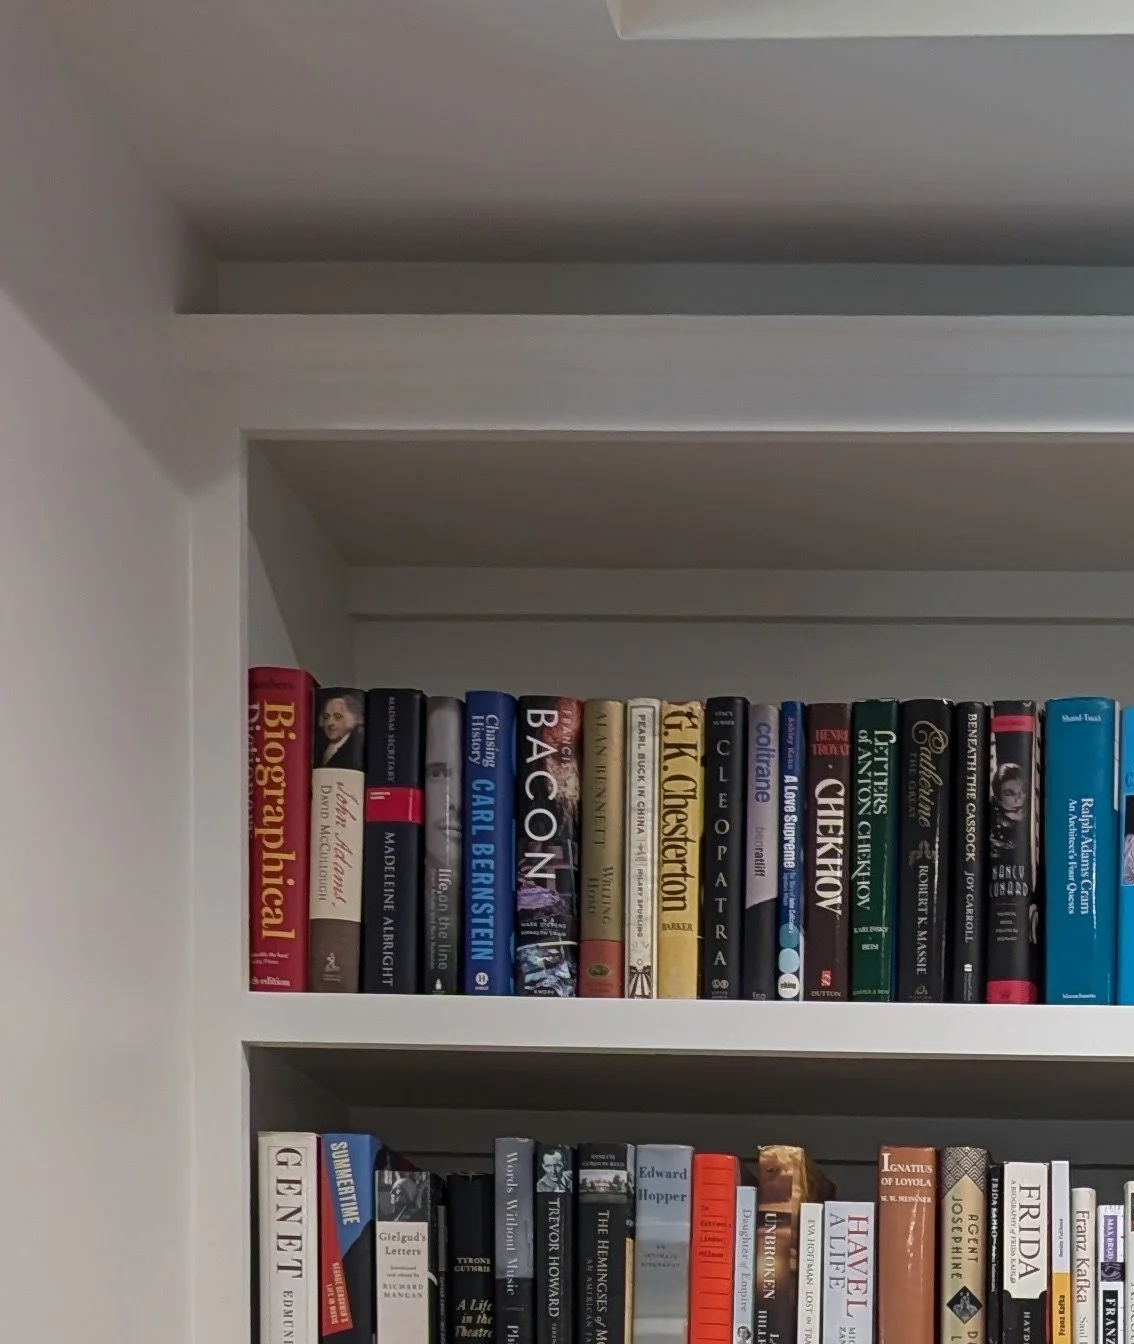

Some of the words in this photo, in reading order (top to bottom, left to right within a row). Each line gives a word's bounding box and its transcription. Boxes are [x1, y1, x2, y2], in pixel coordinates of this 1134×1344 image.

[662, 709, 698, 736] G.
[966, 714, 977, 771] BENEATH
[662, 742, 697, 772] K.
[755, 722, 776, 803] coltrane
[784, 775, 798, 783] A
[471, 779, 493, 835] CARL
[525, 708, 558, 881] BACON
[784, 786, 798, 810] Love
[966, 776, 977, 799] THE
[1078, 798, 1093, 833] Ralph
[255, 701, 297, 939] Biographical
[661, 775, 697, 912] Chesterton
[783, 813, 798, 868] Supreme
[815, 778, 845, 915] CHEKHOV
[966, 803, 976, 861] CASSOCK
[382, 832, 395, 912] MADELEINE
[714, 739, 730, 965] CLEOPATRA
[1080, 836, 1093, 877] Adams
[471, 843, 494, 961] BERNSTEIN
[1080, 880, 1093, 915] Cram
[382, 917, 394, 986] ALBRIGHT
[662, 923, 693, 931] BARKER
[330, 1141, 360, 1225] SUMMERTIME
[275, 1147, 303, 1279] GENET
[829, 1212, 844, 1230] A
[951, 1195, 963, 1280] JOSEPHINE
[967, 1214, 978, 1263] AGENT
[1019, 1184, 1041, 1279] FRIDA
[1076, 1211, 1089, 1252] Franz
[763, 1212, 776, 1300] UNBROKEN
[829, 1234, 845, 1289] LIFE
[846, 1214, 869, 1318] HAVEL
[1076, 1257, 1090, 1303] Kafka
